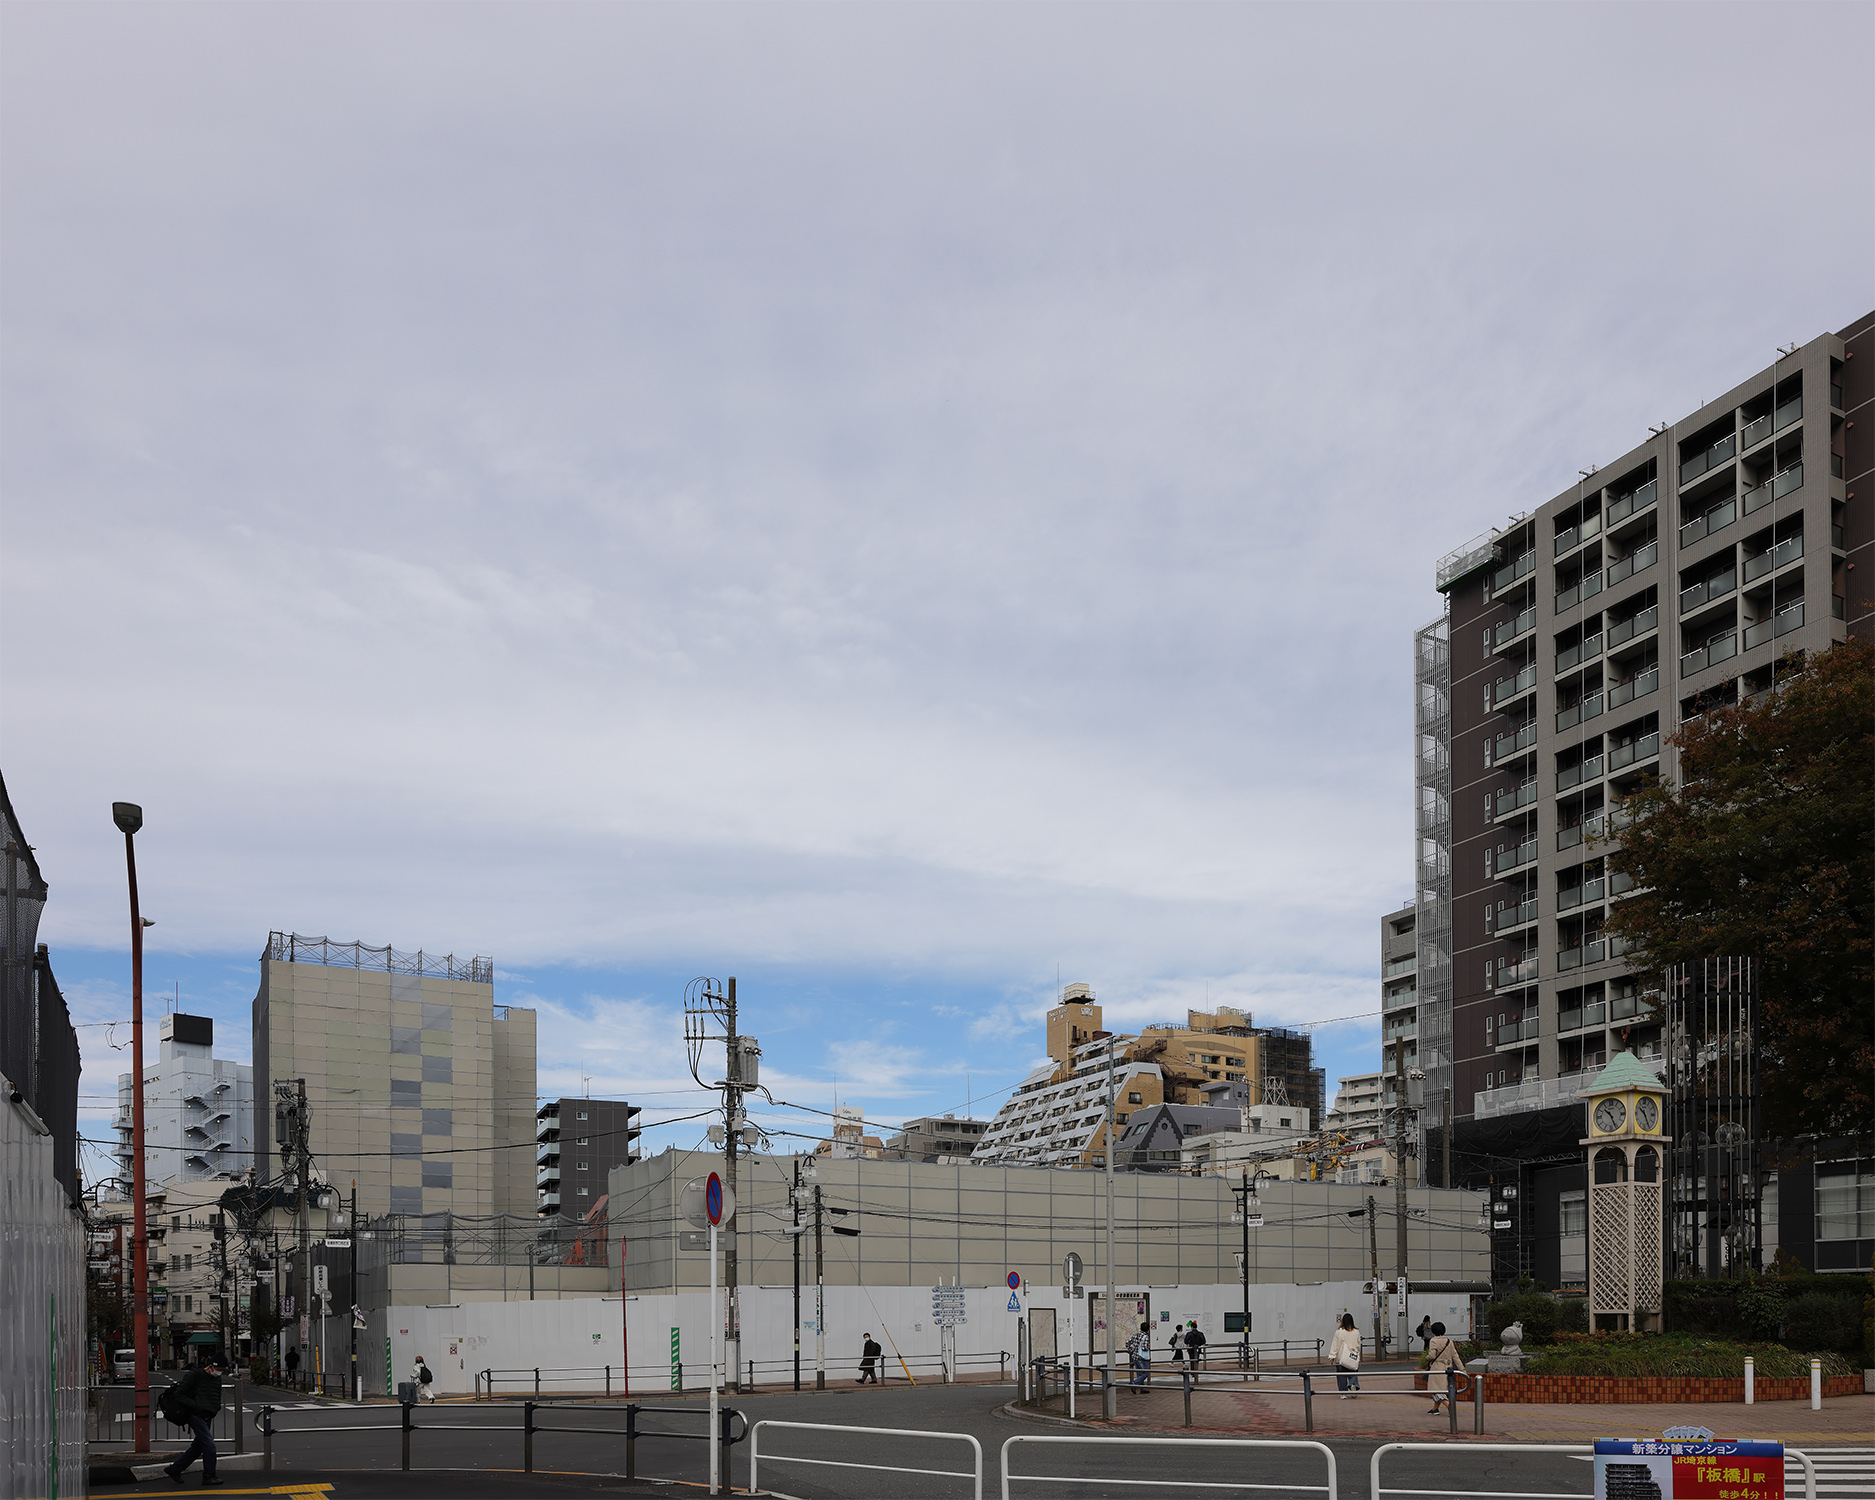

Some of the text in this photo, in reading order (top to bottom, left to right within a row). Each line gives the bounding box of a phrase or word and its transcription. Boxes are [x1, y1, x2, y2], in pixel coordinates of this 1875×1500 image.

[1632, 1443, 1738, 1455] 新築分譲マンション
[1673, 1455, 1718, 1466] JR埼京線
[1697, 1467, 1766, 1484] 『板橋』駅
